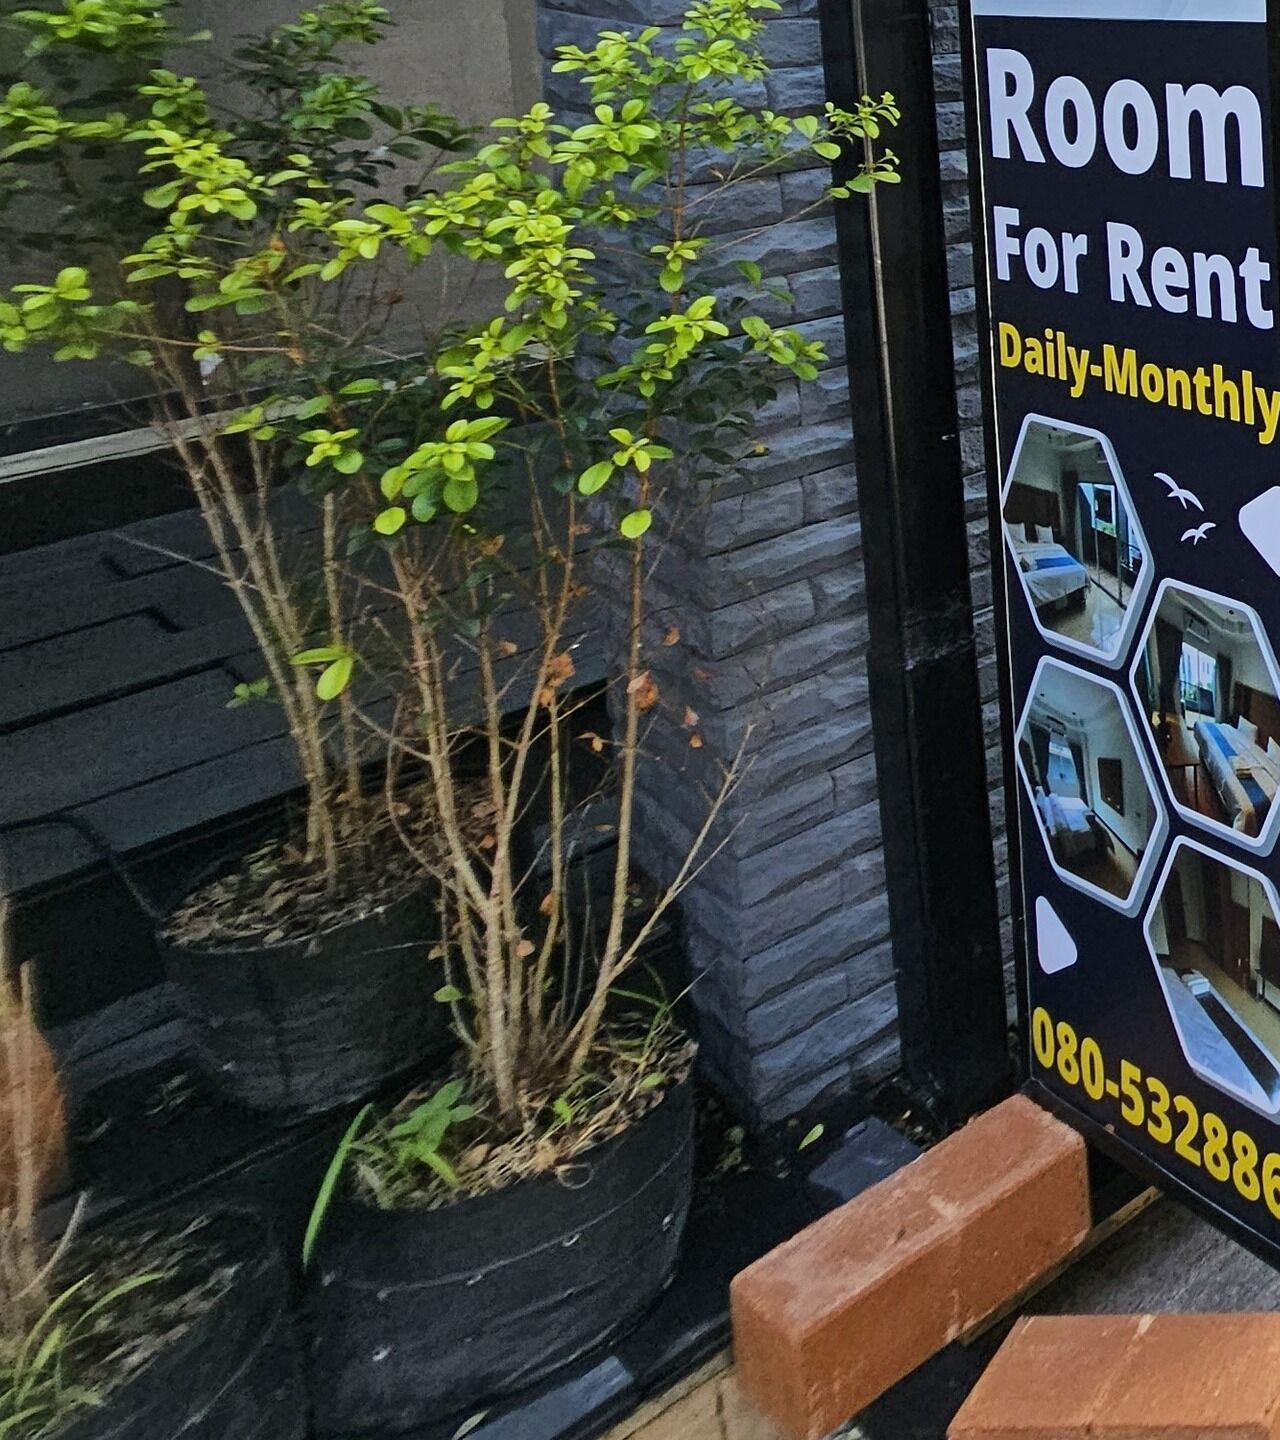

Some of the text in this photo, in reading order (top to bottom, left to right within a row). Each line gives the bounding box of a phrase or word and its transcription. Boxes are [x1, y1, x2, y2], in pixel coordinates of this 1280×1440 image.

[986, 47, 1265, 188] Room
[993, 206, 1275, 330] For Rent
